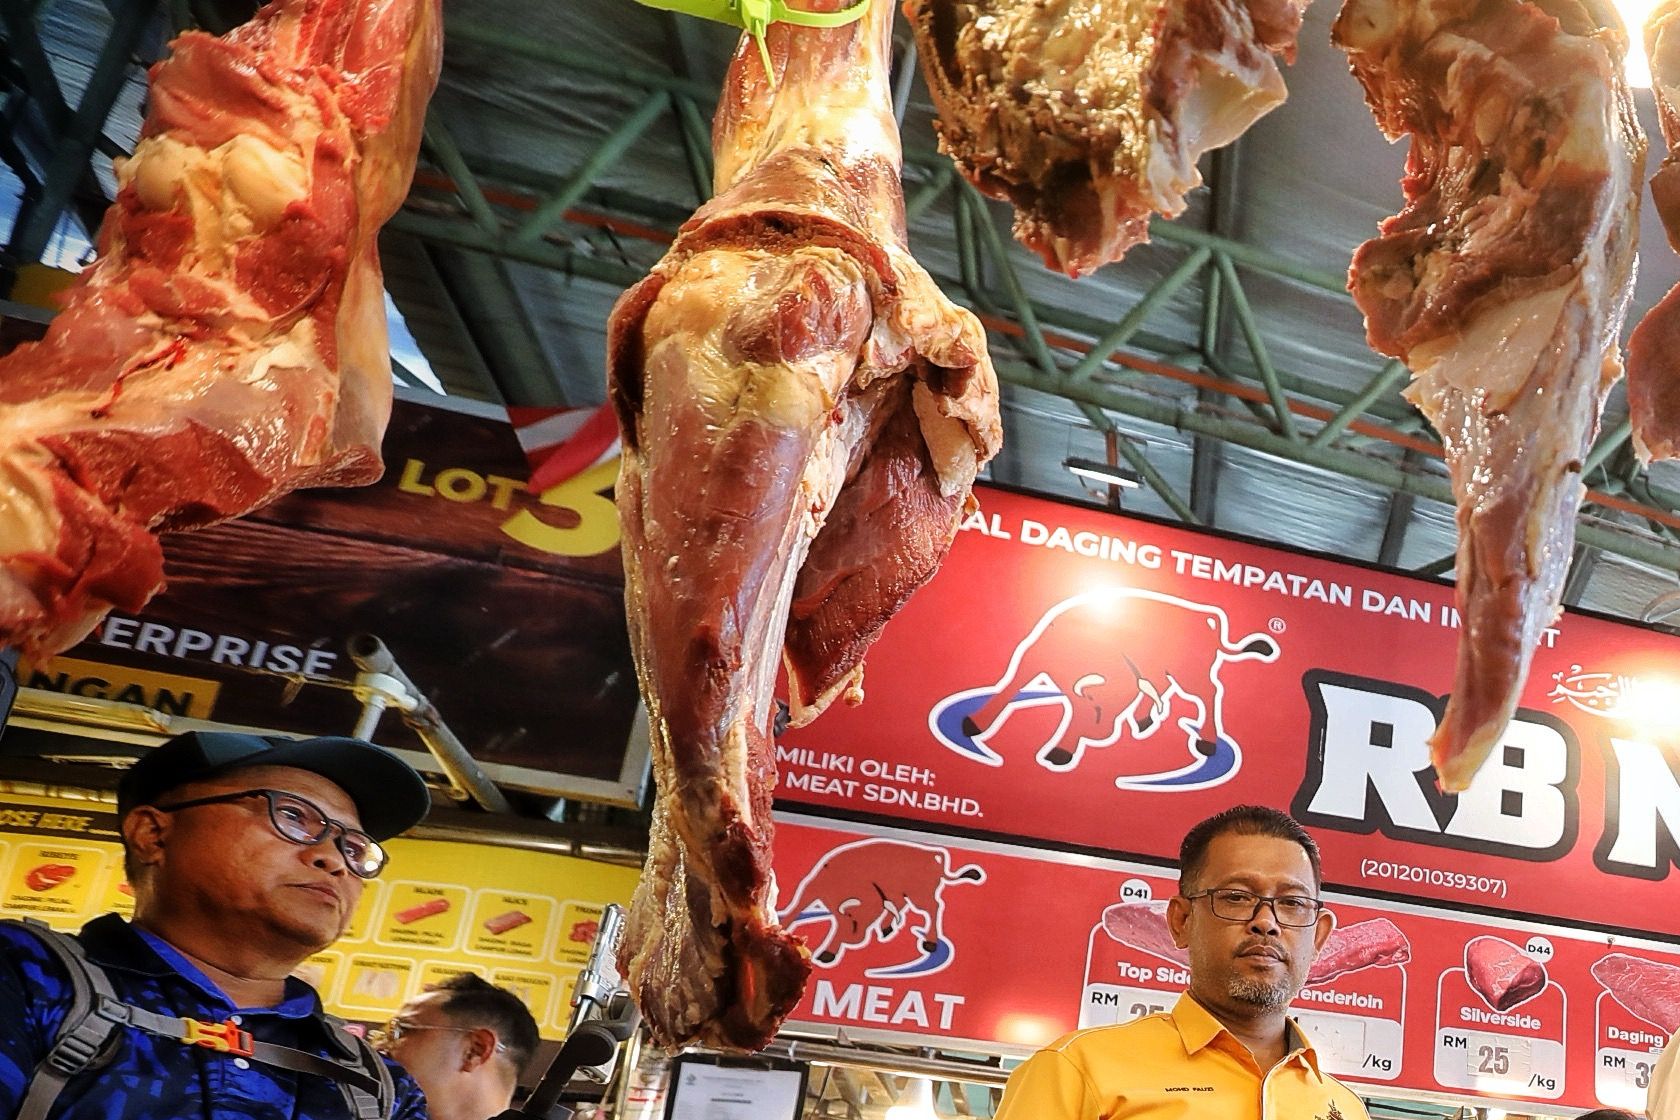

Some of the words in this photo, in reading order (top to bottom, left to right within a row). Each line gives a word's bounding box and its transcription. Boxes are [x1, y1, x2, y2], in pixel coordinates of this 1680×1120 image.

[398, 457, 529, 511] LOT
[959, 510, 1011, 541] AL
[1020, 518, 1164, 569] DAGING
[1171, 548, 1353, 609] TEMPATAN
[1361, 588, 1432, 624] DAN
[99, 615, 338, 680] ERPRISE
[27, 667, 194, 717] NGAN
[775, 745, 855, 774] MILIKI
[860, 759, 936, 787] OLEH:
[1304, 680, 1570, 852] RB
[786, 771, 859, 798] MEAT
[863, 783, 984, 818] SDN.BHD.
[1124, 886, 1148, 899] D41
[1360, 858, 1508, 899] (201201039307)
[1527, 943, 1551, 955] D44
[1116, 961, 1153, 983] Top
[811, 979, 966, 1031] MEAT
[1091, 991, 1119, 1007] RM
[1459, 1006, 1542, 1030] Silverside
[1607, 1026, 1664, 1047] Daging
[1362, 1053, 1392, 1072] /kg
[1443, 1034, 1467, 1049] RM
[1477, 1045, 1510, 1075] 25
[1528, 1073, 1556, 1091] /kg
[1603, 1055, 1626, 1069] RM
